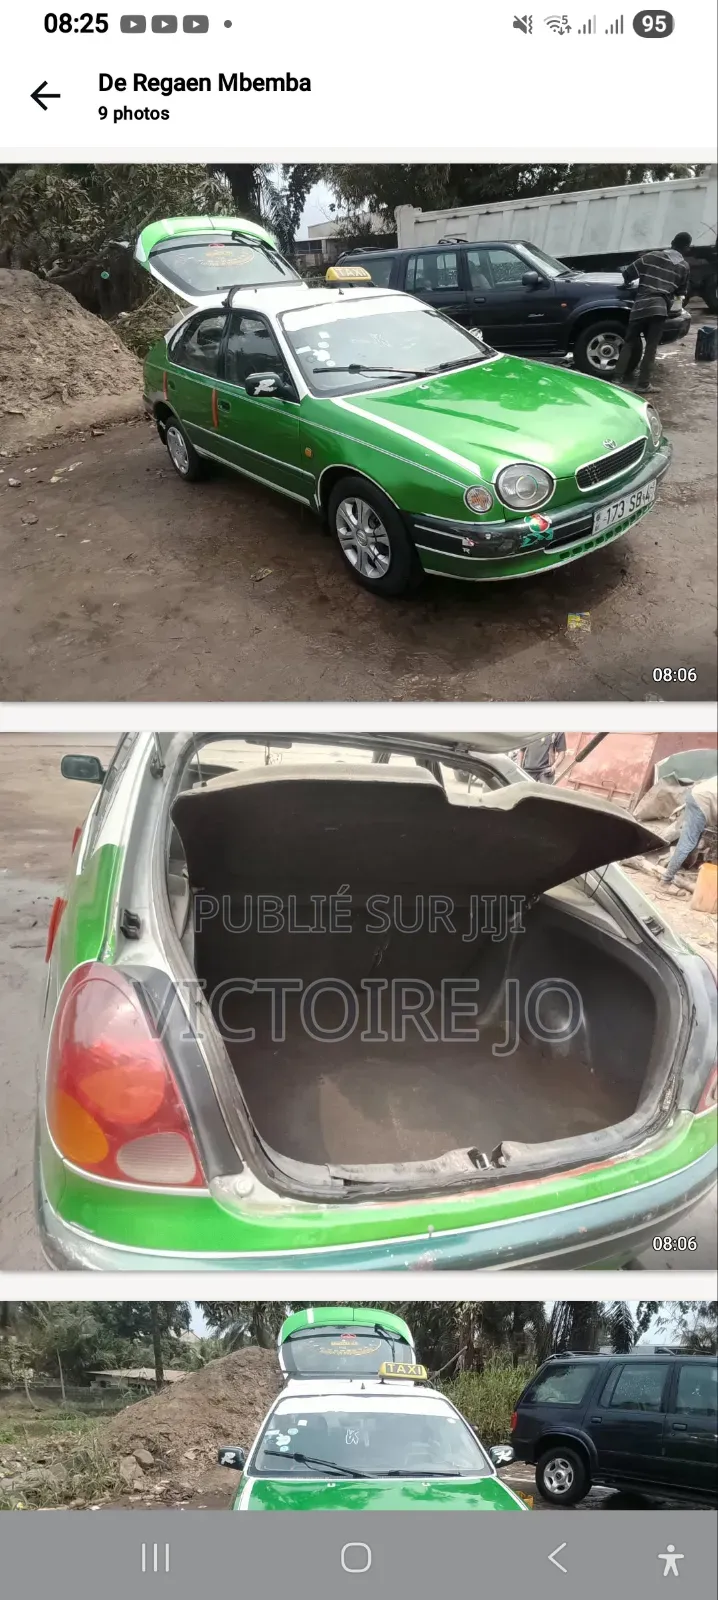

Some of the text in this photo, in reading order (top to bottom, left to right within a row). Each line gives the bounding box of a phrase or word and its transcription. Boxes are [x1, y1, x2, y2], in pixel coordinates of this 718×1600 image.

[43, 13, 109, 34] 08:25
[641, 15, 667, 32] 95
[98, 72, 312, 97] De Regaen Mbemba
[98, 105, 170, 124] 9 photos
[334, 267, 368, 277] TAXI
[386, 1362, 423, 1376] TAXI
